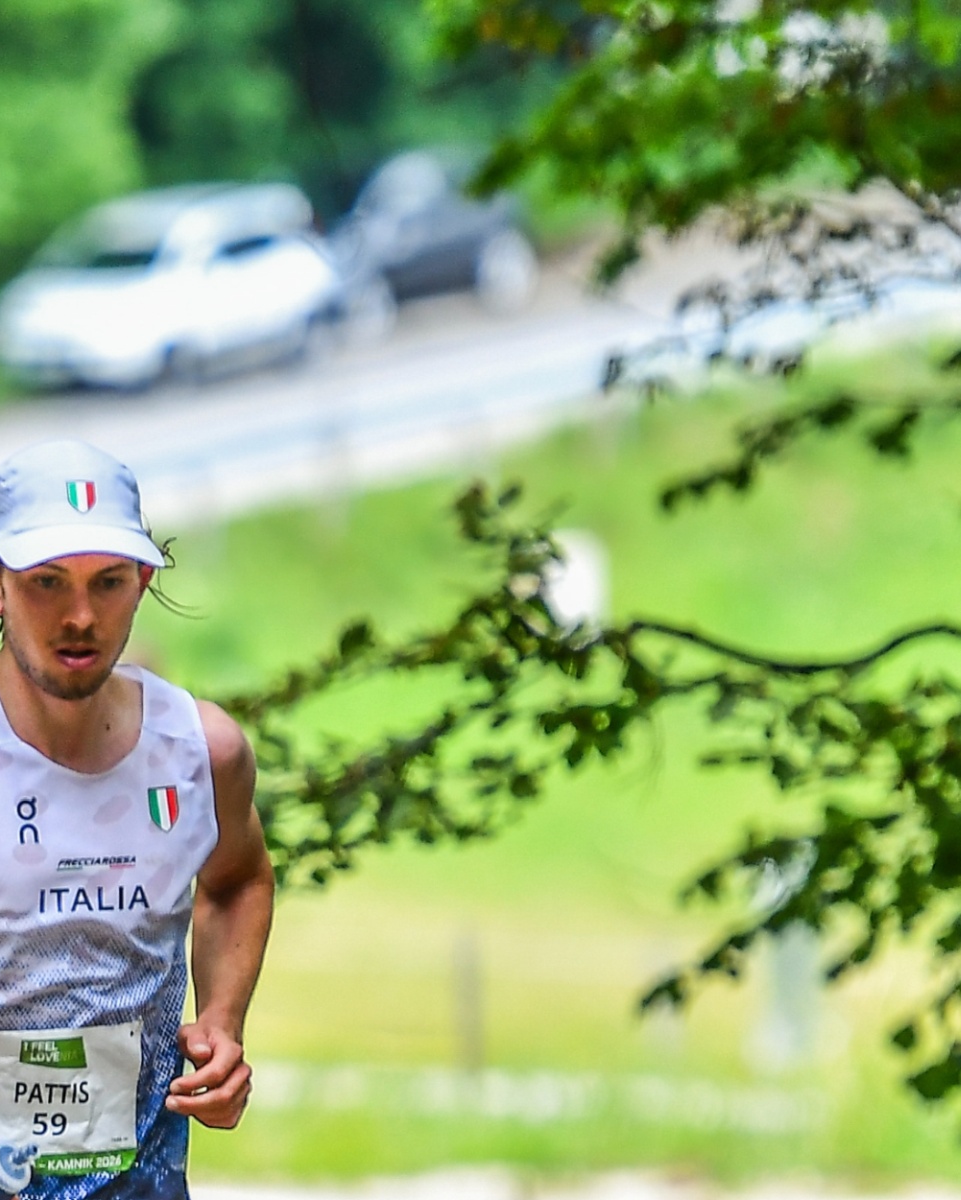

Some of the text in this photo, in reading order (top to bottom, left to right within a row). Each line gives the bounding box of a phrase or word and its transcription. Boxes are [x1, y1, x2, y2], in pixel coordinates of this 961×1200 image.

[58, 855, 136, 867] FRECCIAROSSA
[39, 885, 149, 913] ITALIA
[23, 1041, 58, 1052] I FEEL
[14, 1081, 89, 1104] PATTIS
[32, 1112, 67, 1136] 59
[48, 1157, 94, 1171] KAMNIK
[96, 1154, 122, 1168] 2026
